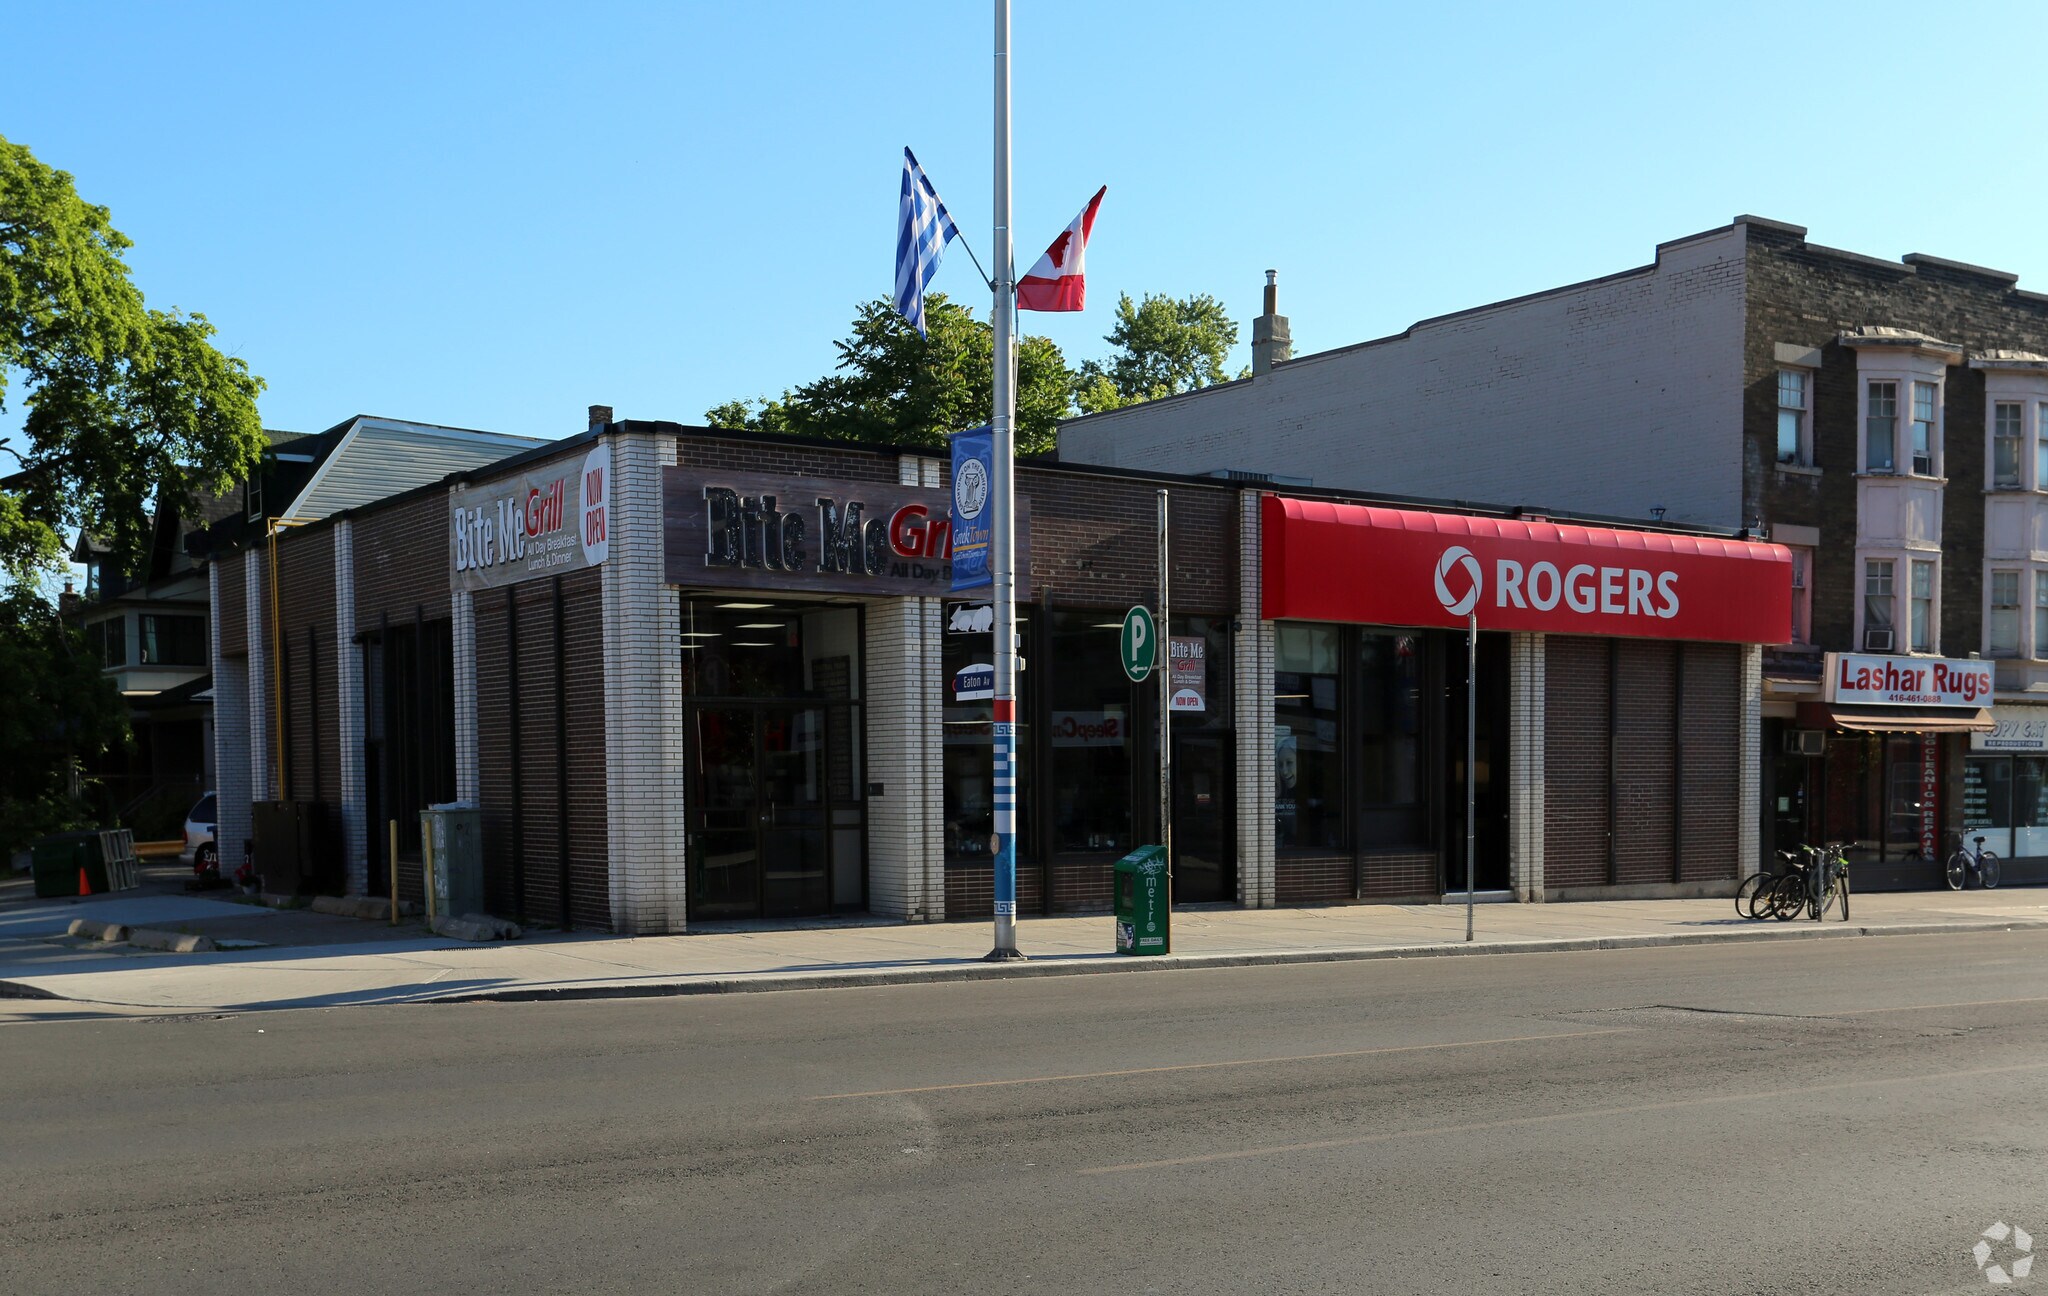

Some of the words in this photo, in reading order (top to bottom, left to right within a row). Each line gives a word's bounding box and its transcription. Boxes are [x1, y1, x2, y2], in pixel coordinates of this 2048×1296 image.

[586, 467, 603, 507] NOW
[525, 478, 566, 539] Grill
[455, 506, 494, 572] Bite
[497, 497, 526, 564] Me
[586, 506, 606, 547] OPEN
[703, 486, 805, 572] Bite
[815, 498, 888, 576] Me
[889, 503, 952, 559] Gri
[527, 542, 535, 556] All
[534, 541, 546, 556] Day
[547, 532, 578, 550] Breakfast
[528, 556, 546, 571] Lunch
[545, 556, 551, 567] &
[551, 551, 573, 566] Dinner
[890, 563, 909, 578] All
[912, 565, 940, 583] Day
[1496, 558, 1681, 620] ROGERS
[1131, 615, 1146, 662] P
[1170, 641, 1188, 658] Bite
[1190, 642, 1203, 659] Me
[963, 676, 981, 688] Eaton
[1178, 660, 1197, 672] Grill
[1840, 659, 1926, 692] Lashar
[1932, 663, 1990, 702] Rugs
[1176, 697, 1186, 706] NOW
[1187, 697, 1199, 706] OPEN
[1888, 694, 1942, 703] 416-461-0888
[1925, 732, 1936, 746] UG
